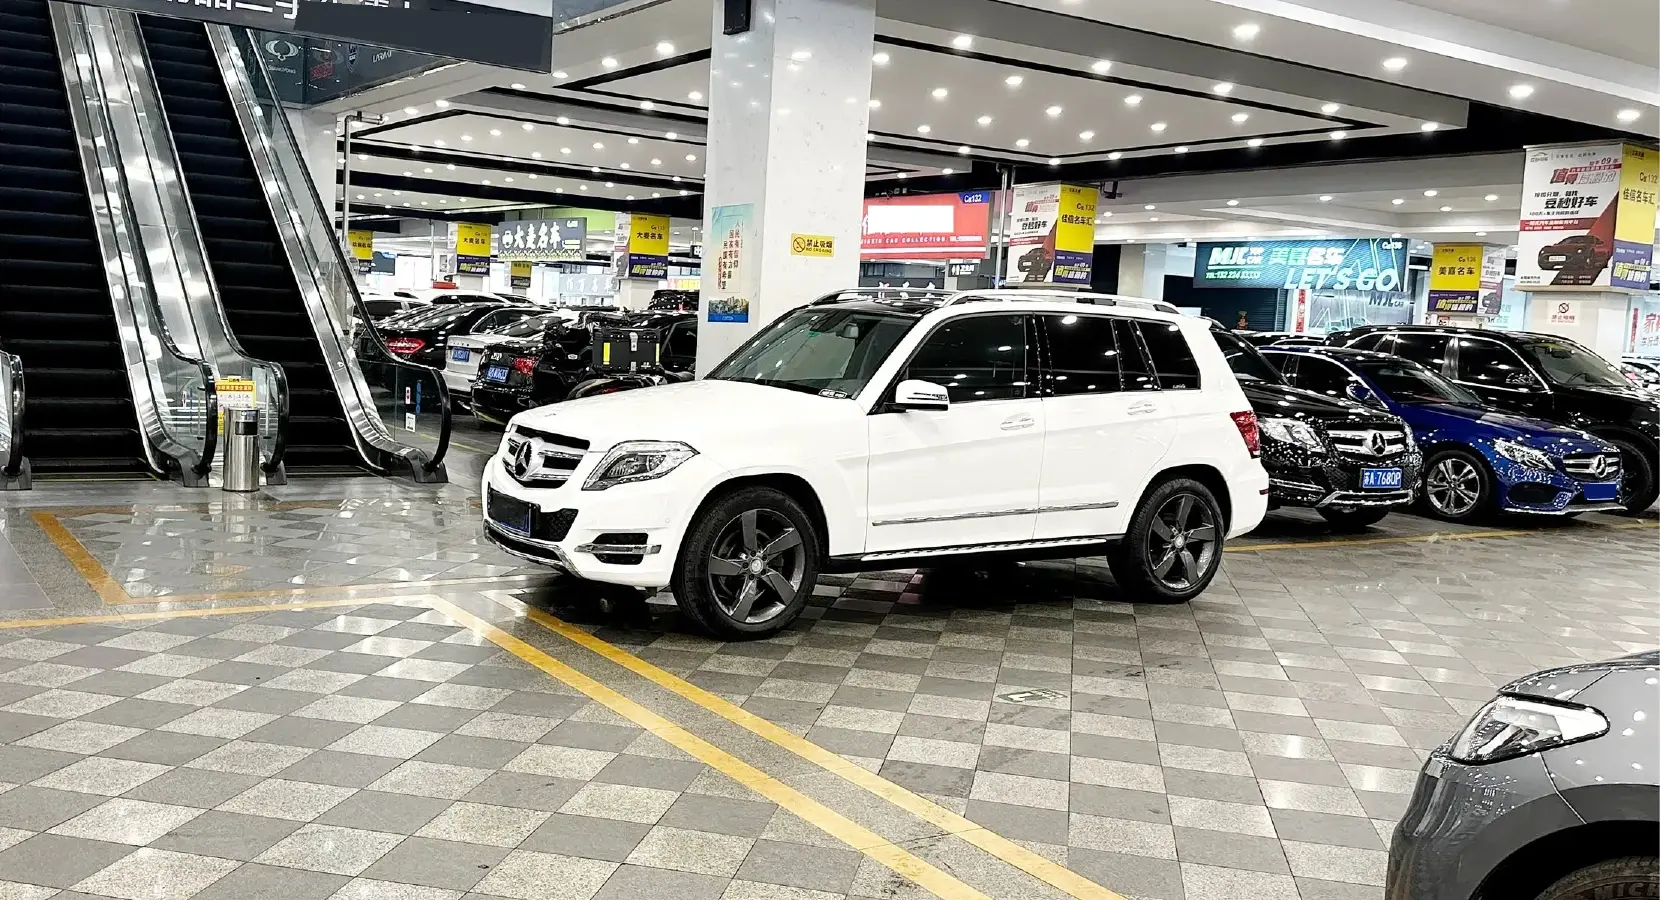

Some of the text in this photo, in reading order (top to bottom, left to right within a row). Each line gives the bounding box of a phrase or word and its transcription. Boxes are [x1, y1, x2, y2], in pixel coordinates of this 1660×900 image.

[806, 239, 832, 248] 禁止吸烟
[1269, 247, 1345, 265] 美嘉名车
[1355, 267, 1399, 291] GO
